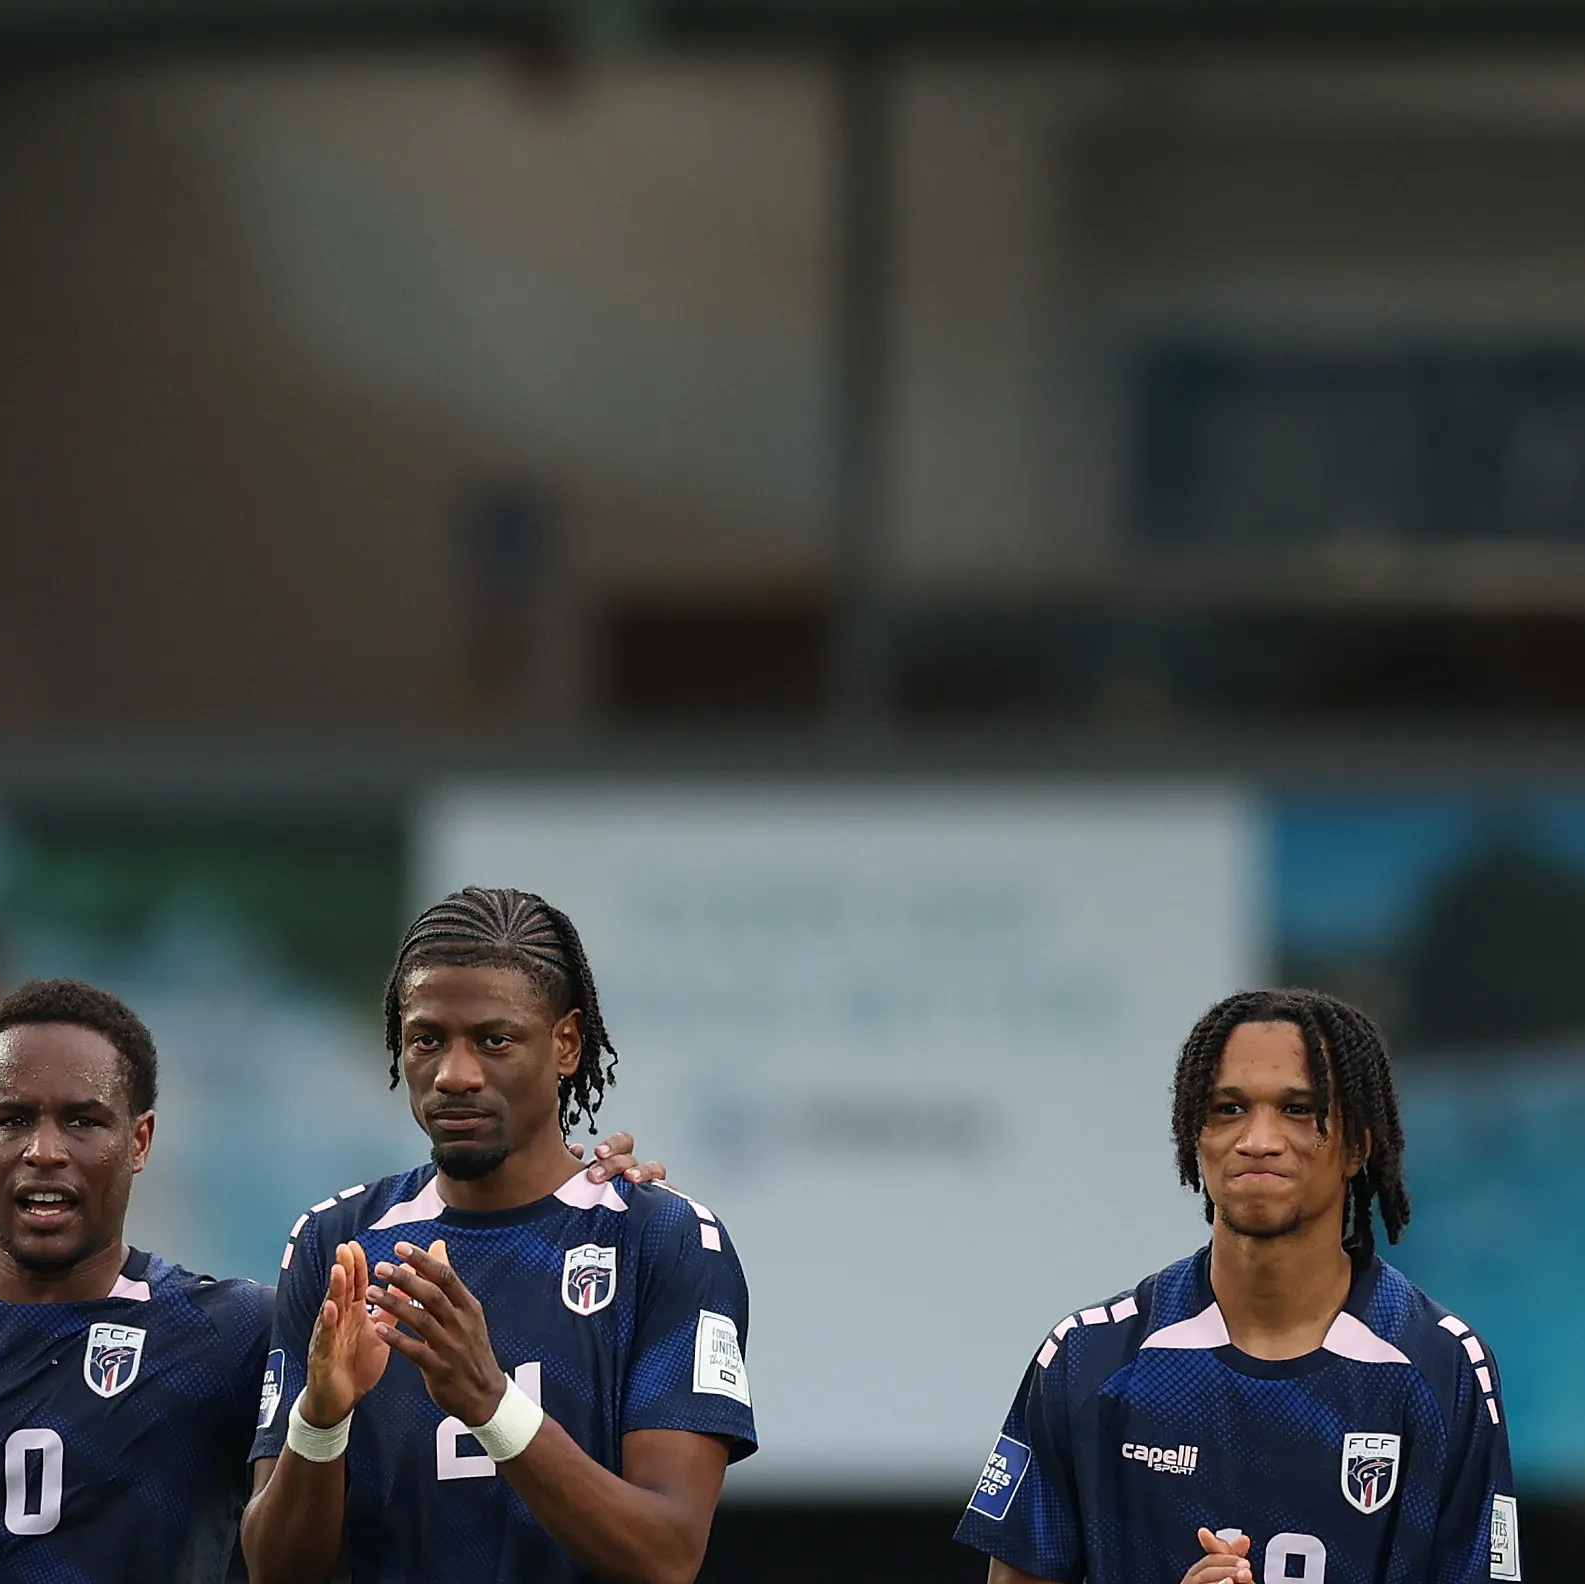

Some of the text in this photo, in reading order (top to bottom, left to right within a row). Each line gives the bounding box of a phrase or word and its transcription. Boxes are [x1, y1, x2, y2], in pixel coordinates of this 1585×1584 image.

[568, 1249, 612, 1263] FCF
[94, 1327, 140, 1341] FCF
[1348, 1437, 1396, 1450] FCF
[989, 1452, 1008, 1472] FA
[1121, 1442, 1199, 1468] capelli
[1153, 1463, 1196, 1476] SPORT
[982, 1466, 1013, 1488] RIES
